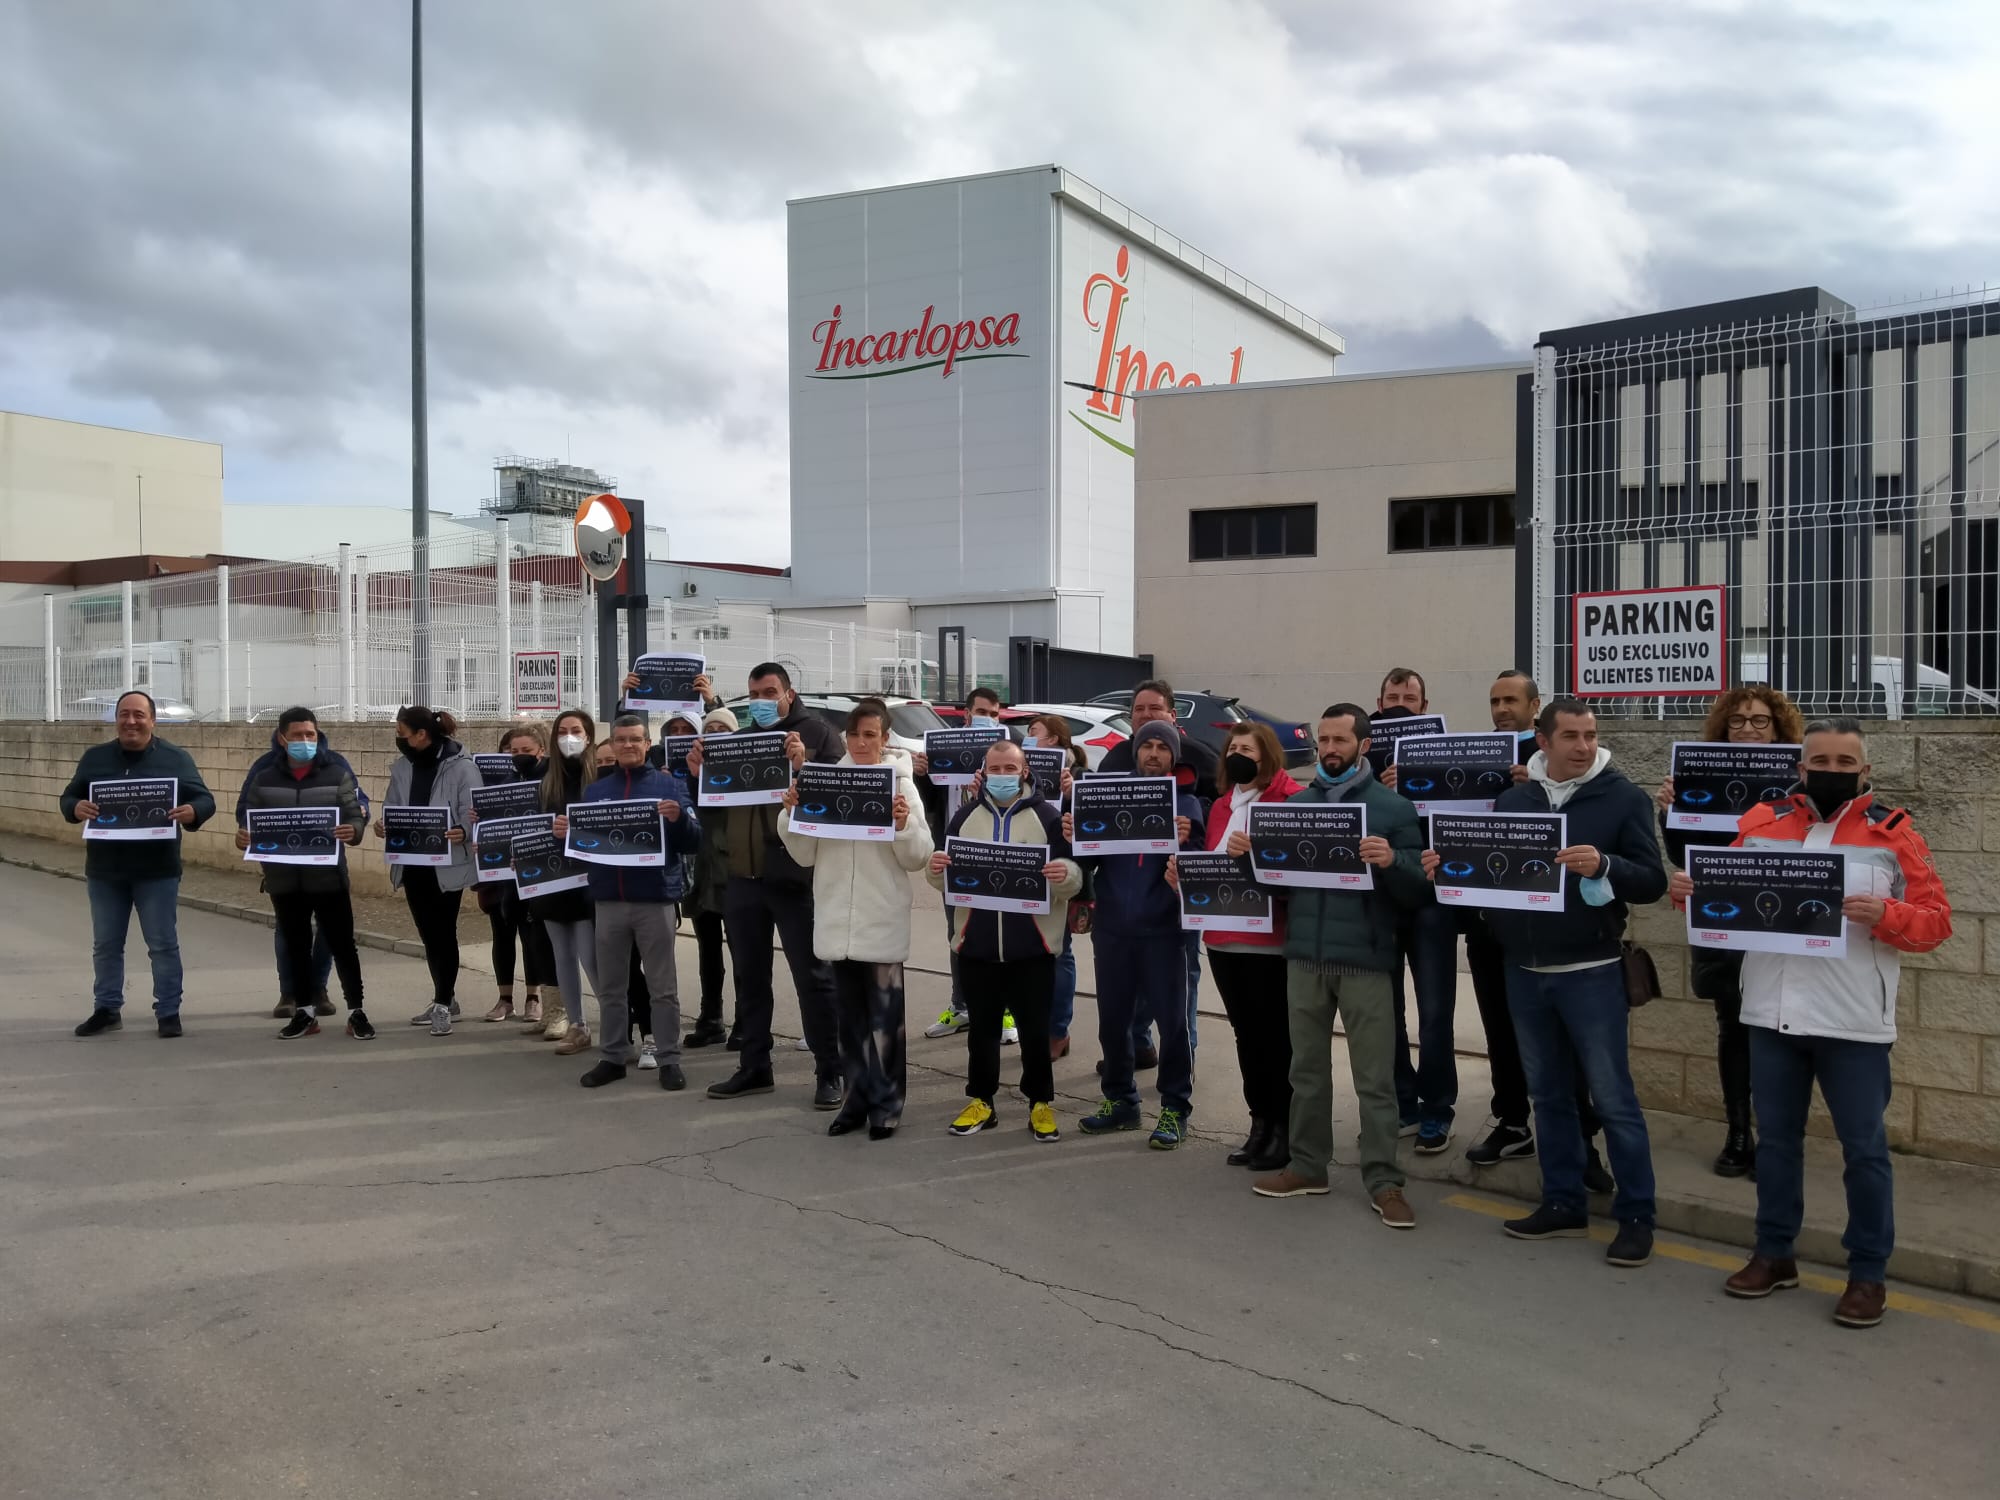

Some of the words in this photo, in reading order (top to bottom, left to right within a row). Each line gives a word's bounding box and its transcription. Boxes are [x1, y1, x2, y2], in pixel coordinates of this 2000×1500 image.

[812, 304, 1020, 378] Incarlopsa
[1585, 598, 1714, 637] PARKING
[1588, 646, 1618, 662] USO
[1623, 642, 1709, 661] EXCLUSIVO
[519, 659, 556, 677] PARKING
[1583, 667, 1653, 684] CLIENTES
[1658, 666, 1715, 682] TIENDA
[530, 681, 554, 690] EXCLUSIVO
[519, 694, 538, 703] CLIENTES
[539, 693, 556, 702] TIENDA
[1510, 823, 1555, 831] PRECIOS,
[951, 845, 988, 854] CONTENER
[955, 853, 993, 861] PROTEGER
[1695, 857, 1755, 865] CONTENER
[1784, 859, 1836, 869] PRECIOS,
[1703, 868, 1762, 876] PROTEGER
[1782, 870, 1829, 878] EMPLEO
